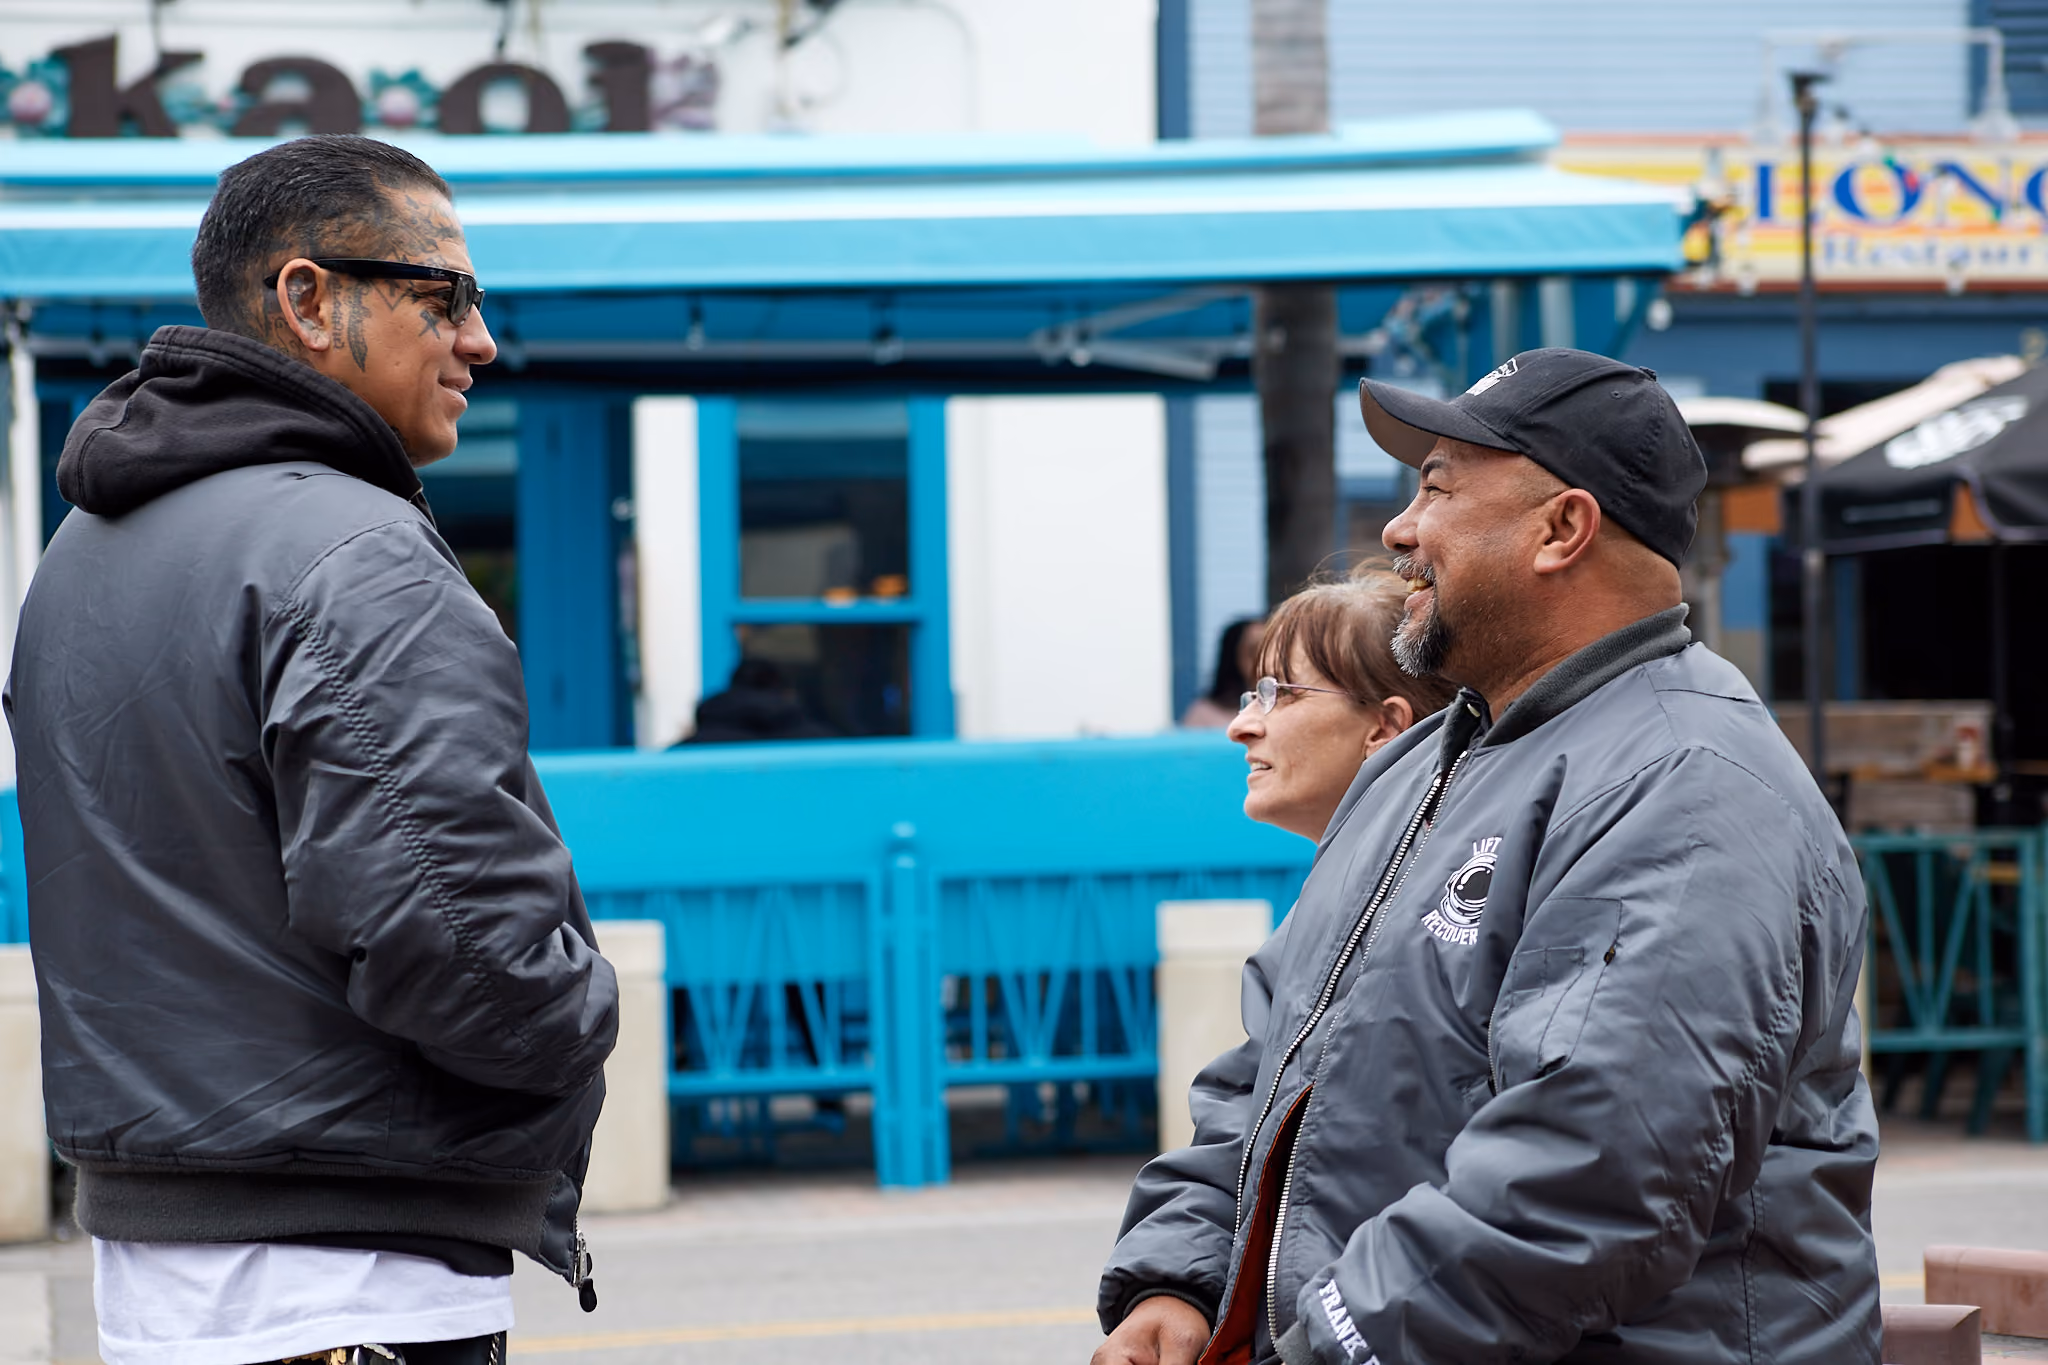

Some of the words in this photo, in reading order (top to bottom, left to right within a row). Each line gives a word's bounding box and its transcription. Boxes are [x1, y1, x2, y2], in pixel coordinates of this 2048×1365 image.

[1757, 163, 2048, 223] LON
[1824, 237, 2048, 266] Restaur
[1473, 837, 1503, 855] LIFT
[1318, 1278, 1369, 1359] FRANK
